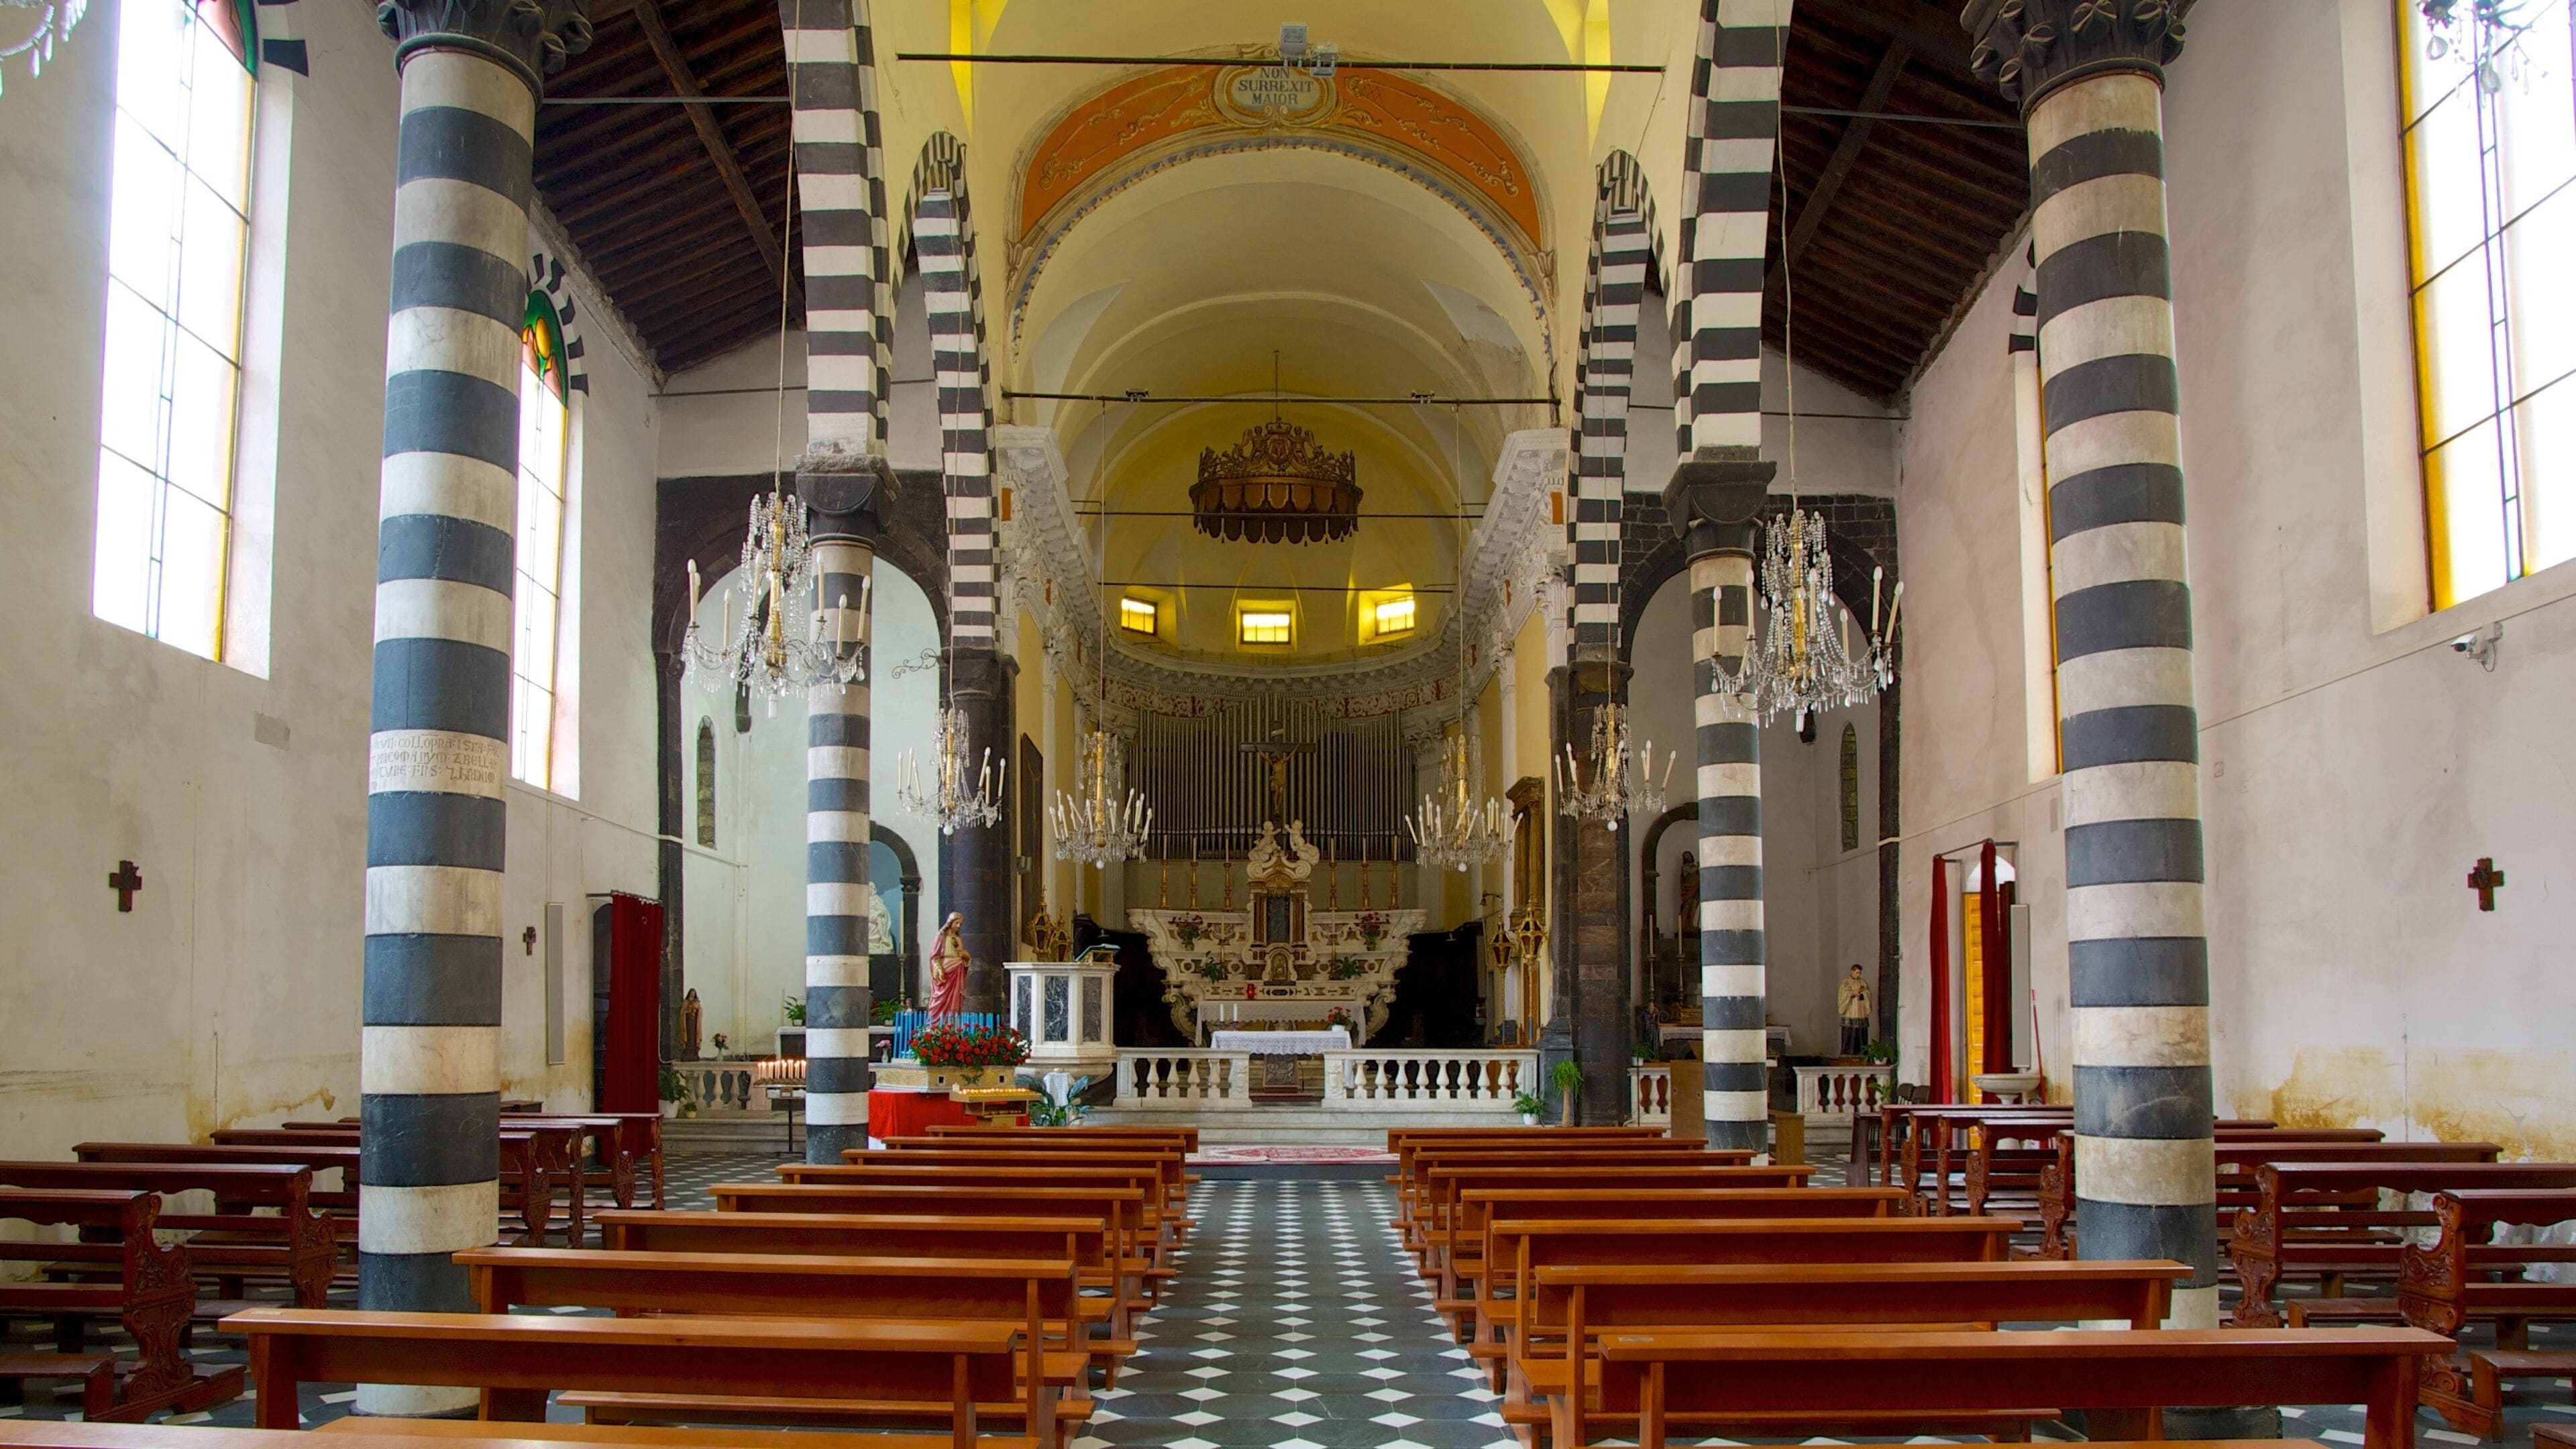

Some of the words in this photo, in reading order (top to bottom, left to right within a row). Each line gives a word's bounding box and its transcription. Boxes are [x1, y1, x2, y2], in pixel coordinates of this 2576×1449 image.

[1260, 67, 1290, 79] NON
[1238, 80, 1313, 93] SURREXIT
[1252, 93, 1299, 105] MAIOR
